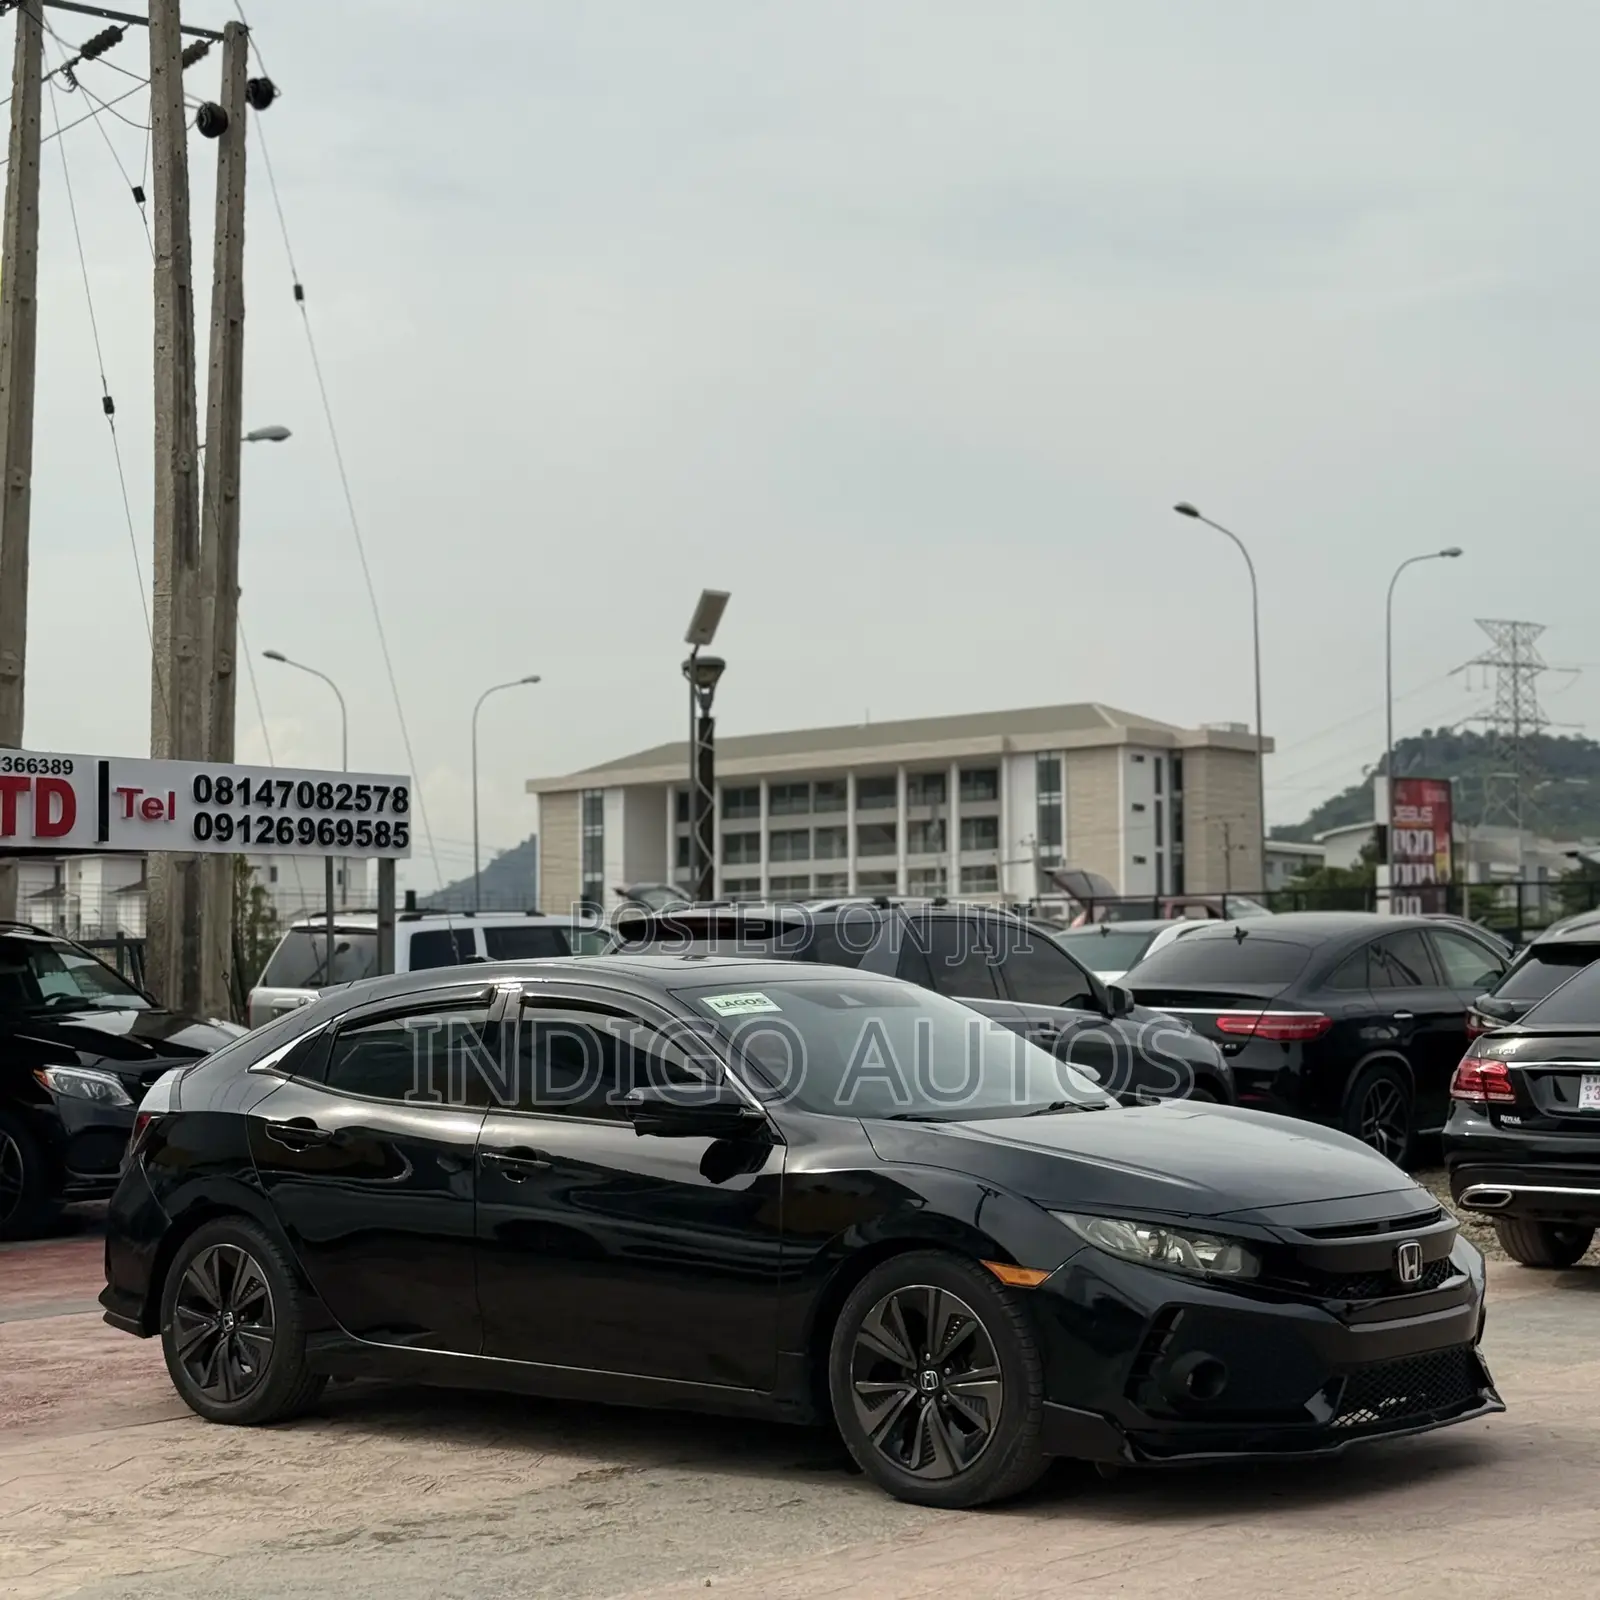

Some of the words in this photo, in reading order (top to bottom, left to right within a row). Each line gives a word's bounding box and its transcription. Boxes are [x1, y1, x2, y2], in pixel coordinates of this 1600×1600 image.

[0, 775, 76, 837] TD
[116, 787, 175, 821] Tel
[193, 774, 409, 813] 08147082578
[193, 812, 409, 848] 09126969585
[714, 998, 767, 1008] LAGOS
